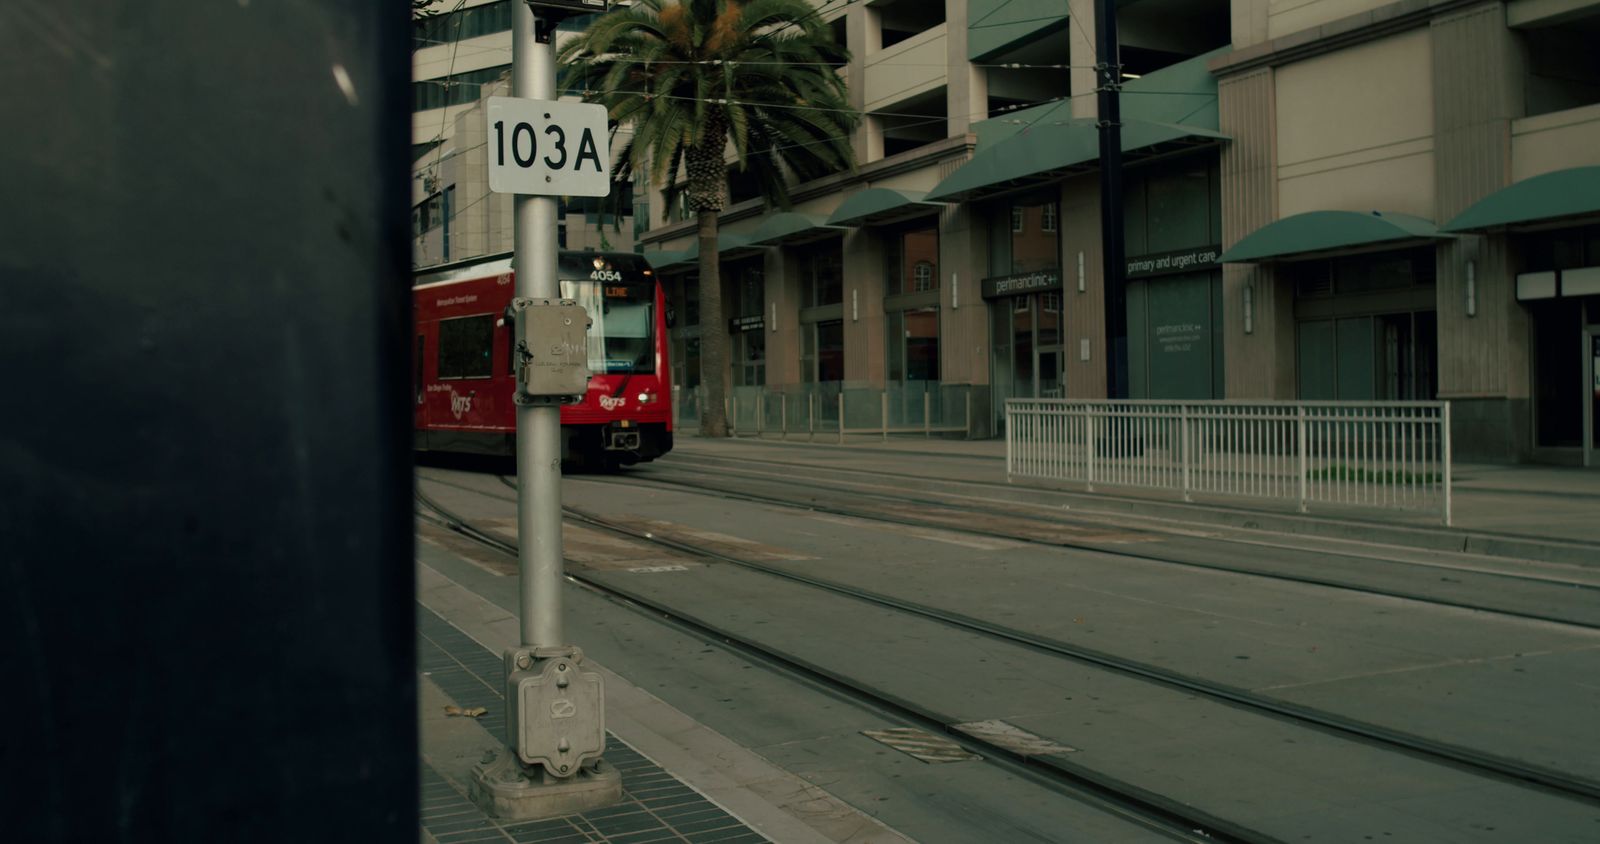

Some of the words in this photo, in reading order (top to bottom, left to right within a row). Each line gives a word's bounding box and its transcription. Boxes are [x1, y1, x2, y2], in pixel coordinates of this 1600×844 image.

[494, 120, 603, 172] 103A
[1127, 260, 1155, 275] primary
[1156, 256, 1170, 269] and
[1171, 252, 1196, 269] urgent
[1198, 251, 1216, 264] care
[590, 270, 622, 282] 4054
[605, 286, 628, 297] LINE
[451, 393, 471, 416] MTS
[599, 395, 626, 409] MTS
